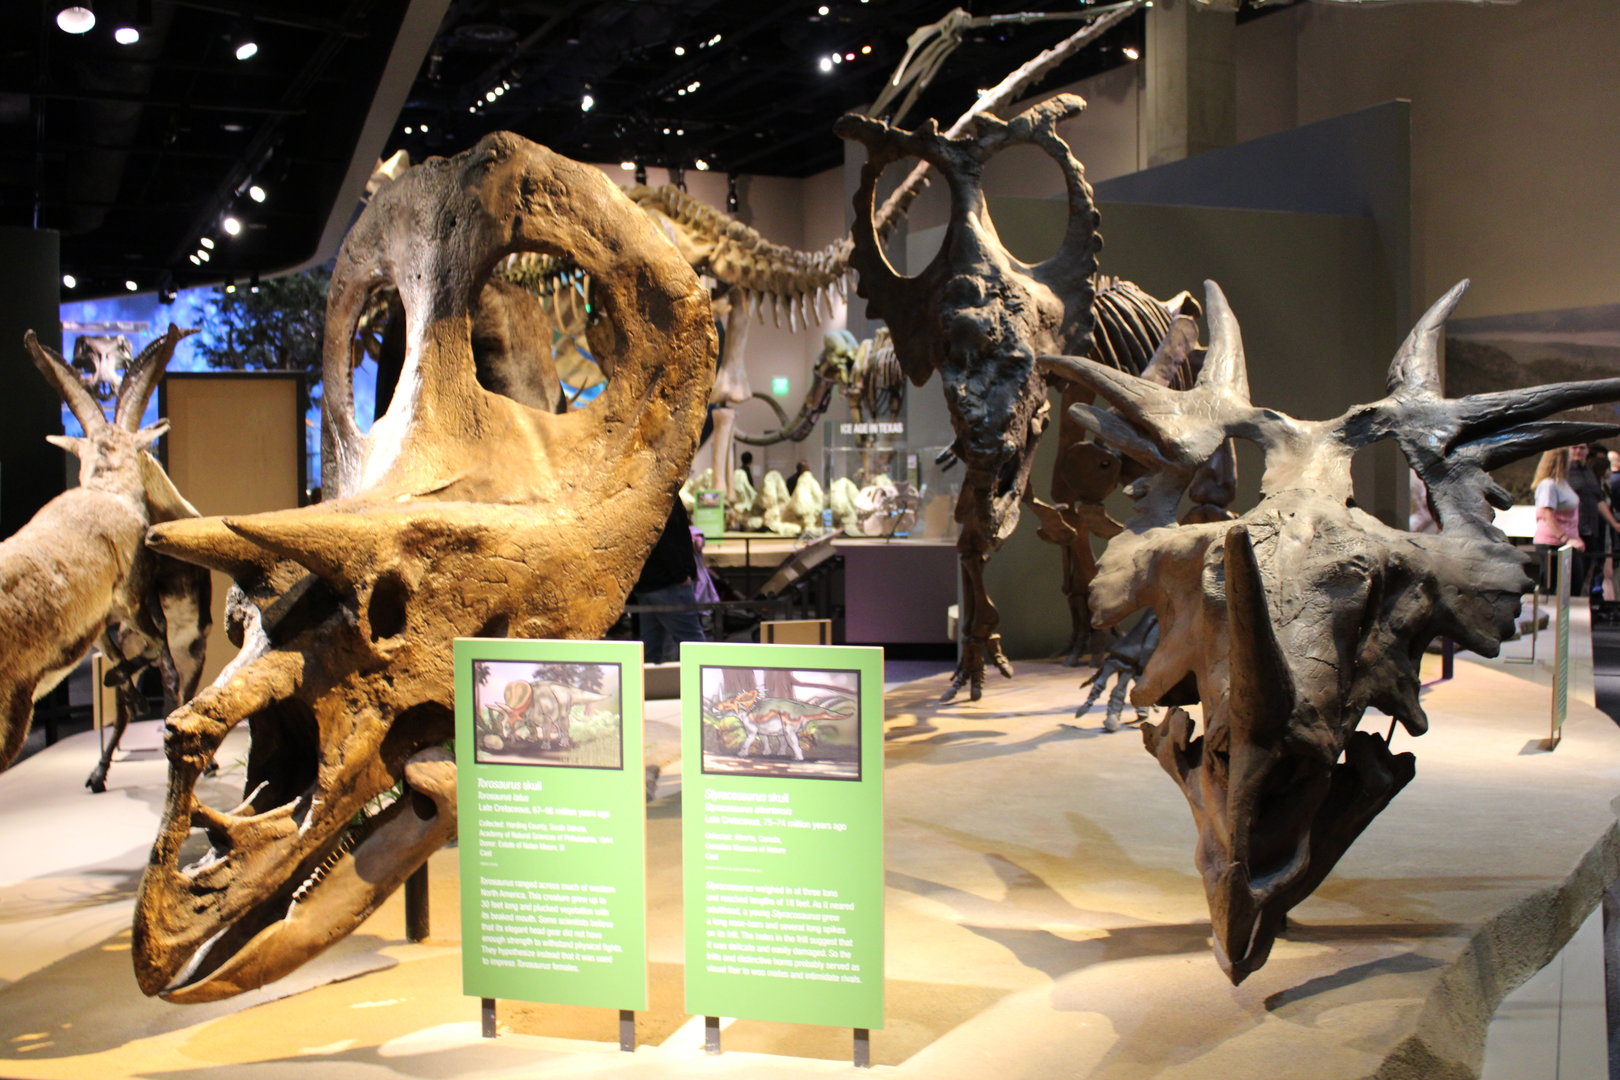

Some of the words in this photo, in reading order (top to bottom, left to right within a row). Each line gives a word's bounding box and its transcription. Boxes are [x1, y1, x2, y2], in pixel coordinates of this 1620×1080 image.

[840, 423, 852, 434] ICE
[854, 422, 868, 434] AGE
[879, 422, 903, 434] TEXAS
[478, 778, 521, 790] Torosaurus
[523, 780, 542, 791] skull
[833, 824, 847, 832] ago
